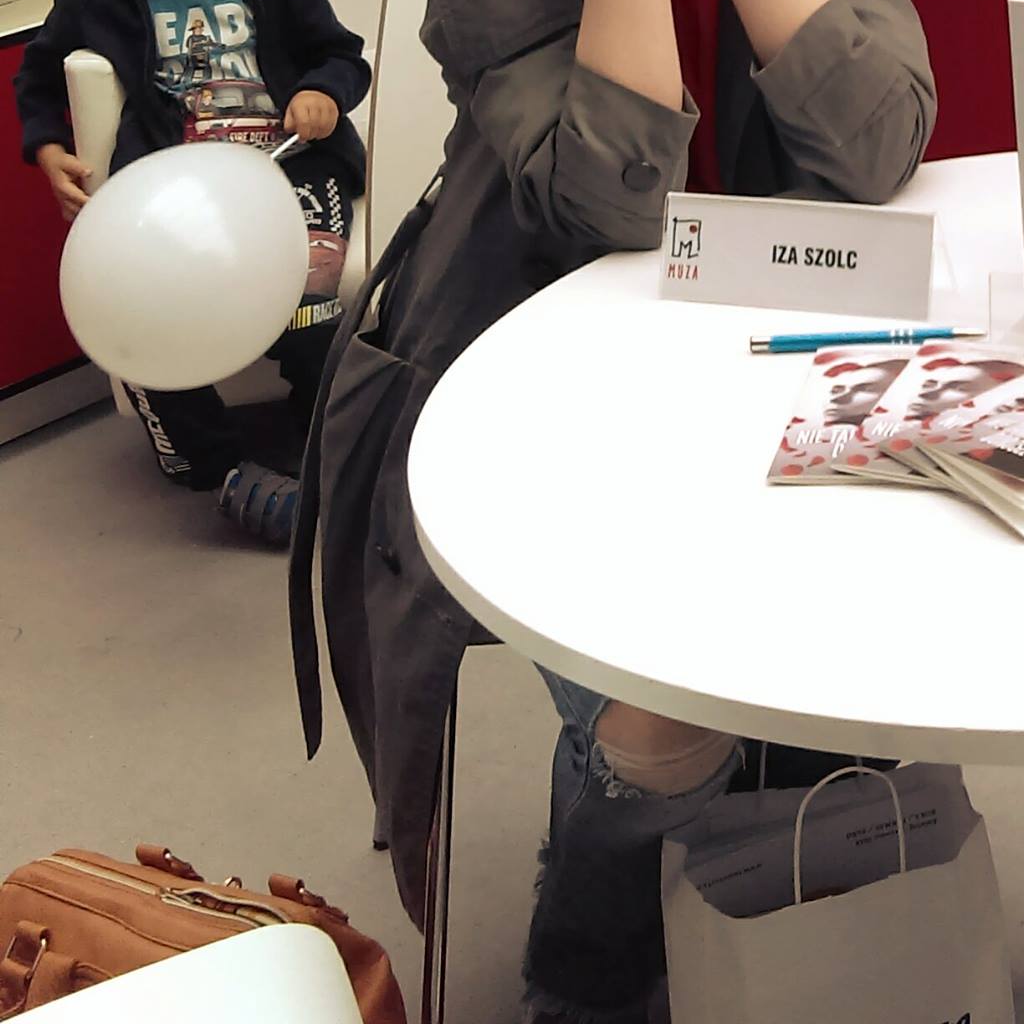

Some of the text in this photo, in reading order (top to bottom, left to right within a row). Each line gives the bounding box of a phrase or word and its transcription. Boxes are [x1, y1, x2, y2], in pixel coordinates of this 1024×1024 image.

[771, 244, 858, 270] IZA SZOLC
[667, 262, 699, 281] MUZA
